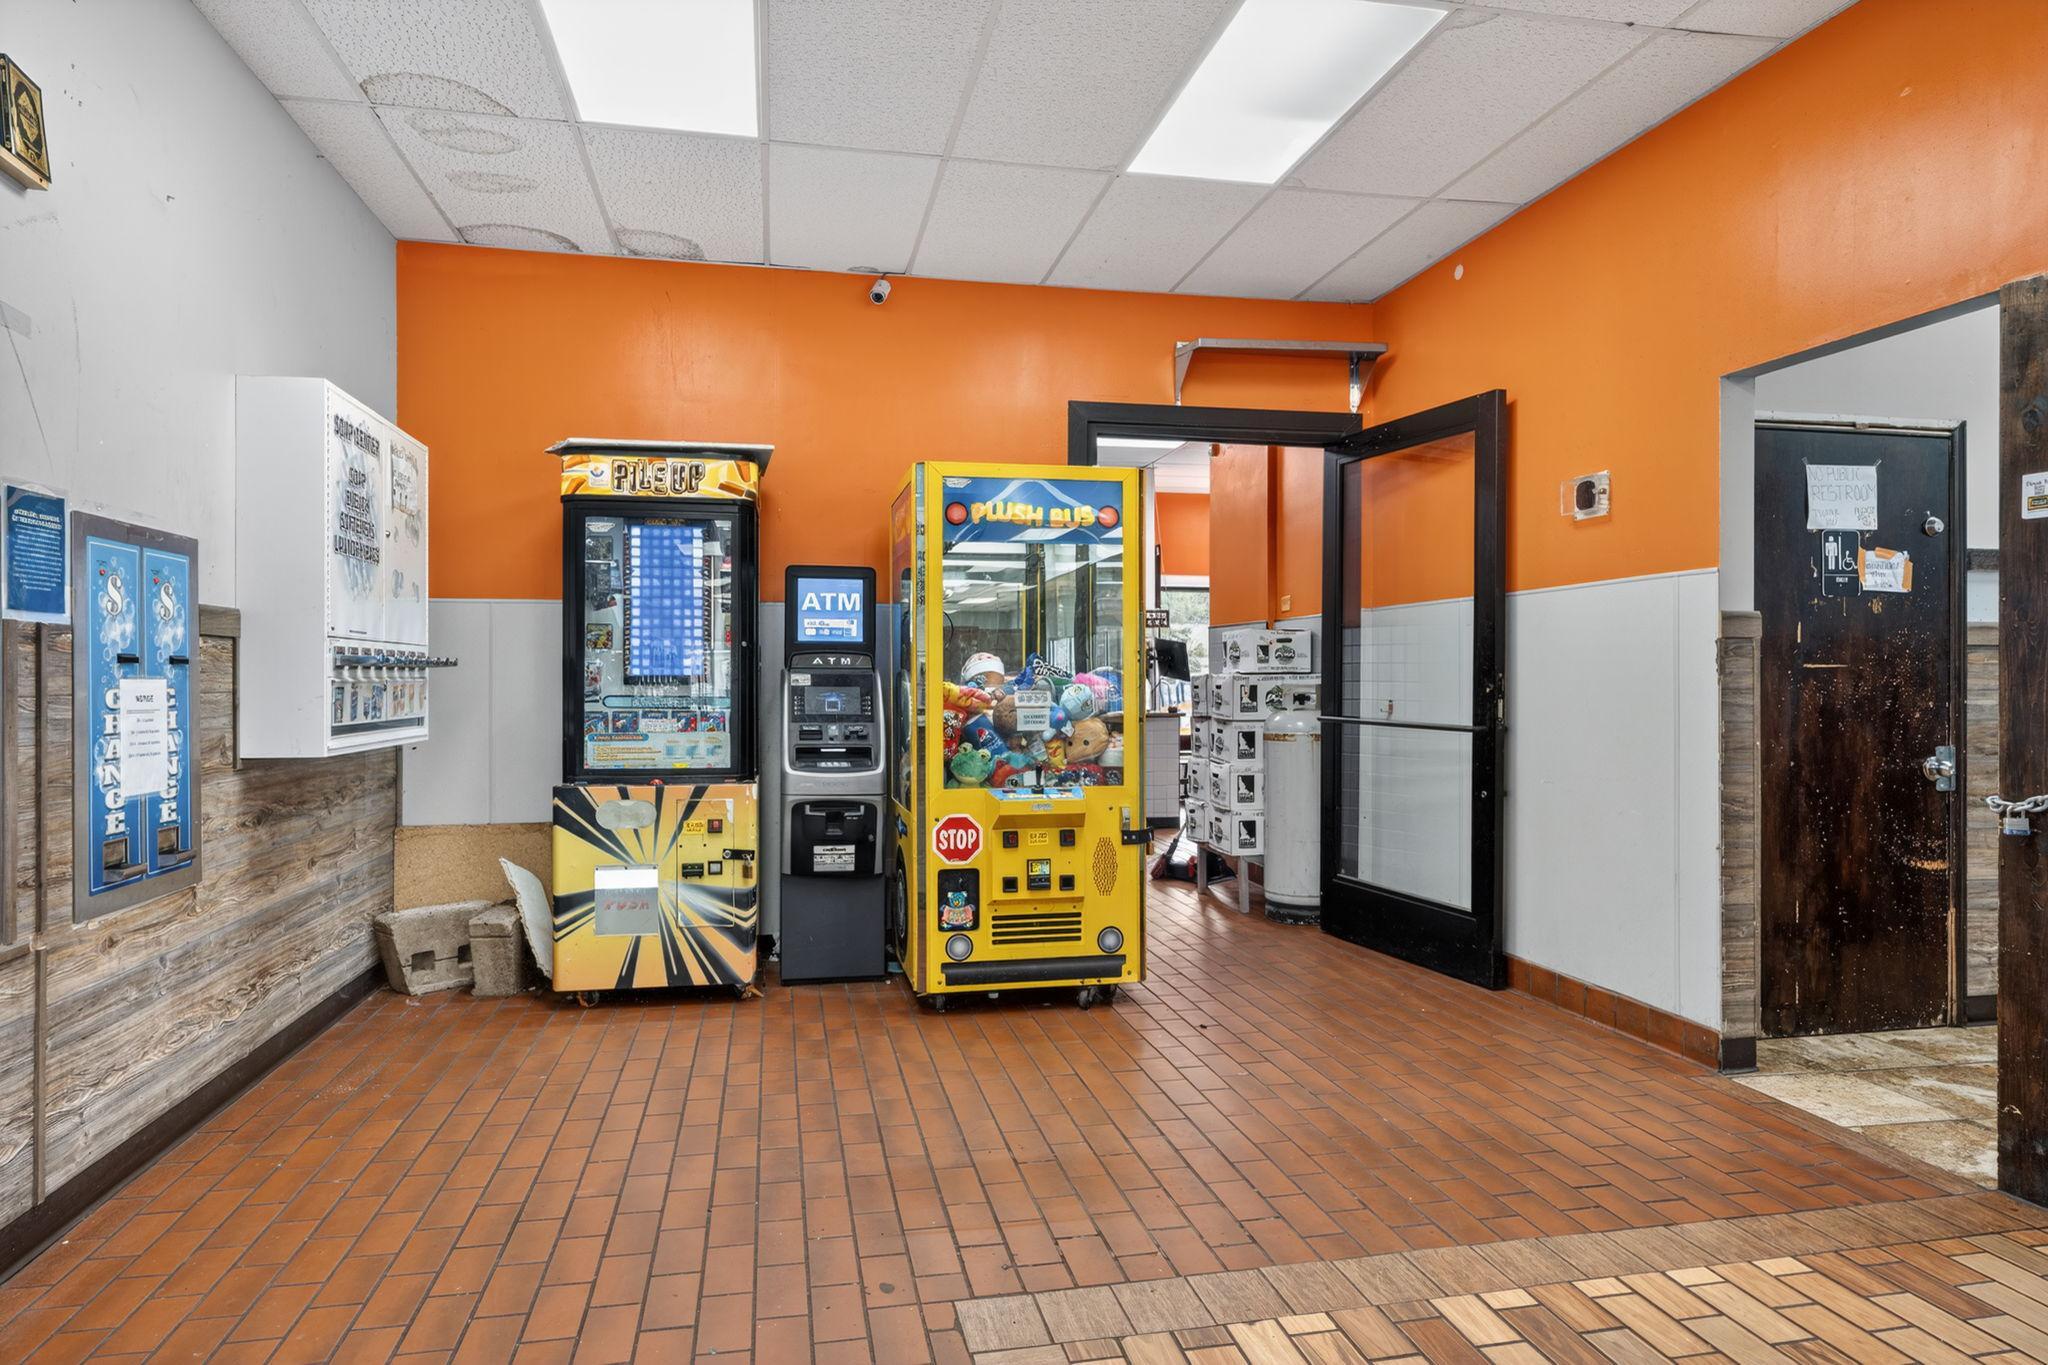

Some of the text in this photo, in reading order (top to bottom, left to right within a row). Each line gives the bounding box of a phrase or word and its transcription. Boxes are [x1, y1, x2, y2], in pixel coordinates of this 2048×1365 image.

[1807, 466, 1861, 481] NO PUBLIC
[1810, 483, 1876, 503] RESTROOM
[970, 501, 1096, 528] PLUSH BUS
[801, 592, 861, 611] ATM
[812, 657, 851, 665] ATM
[938, 828, 977, 850] STOP
